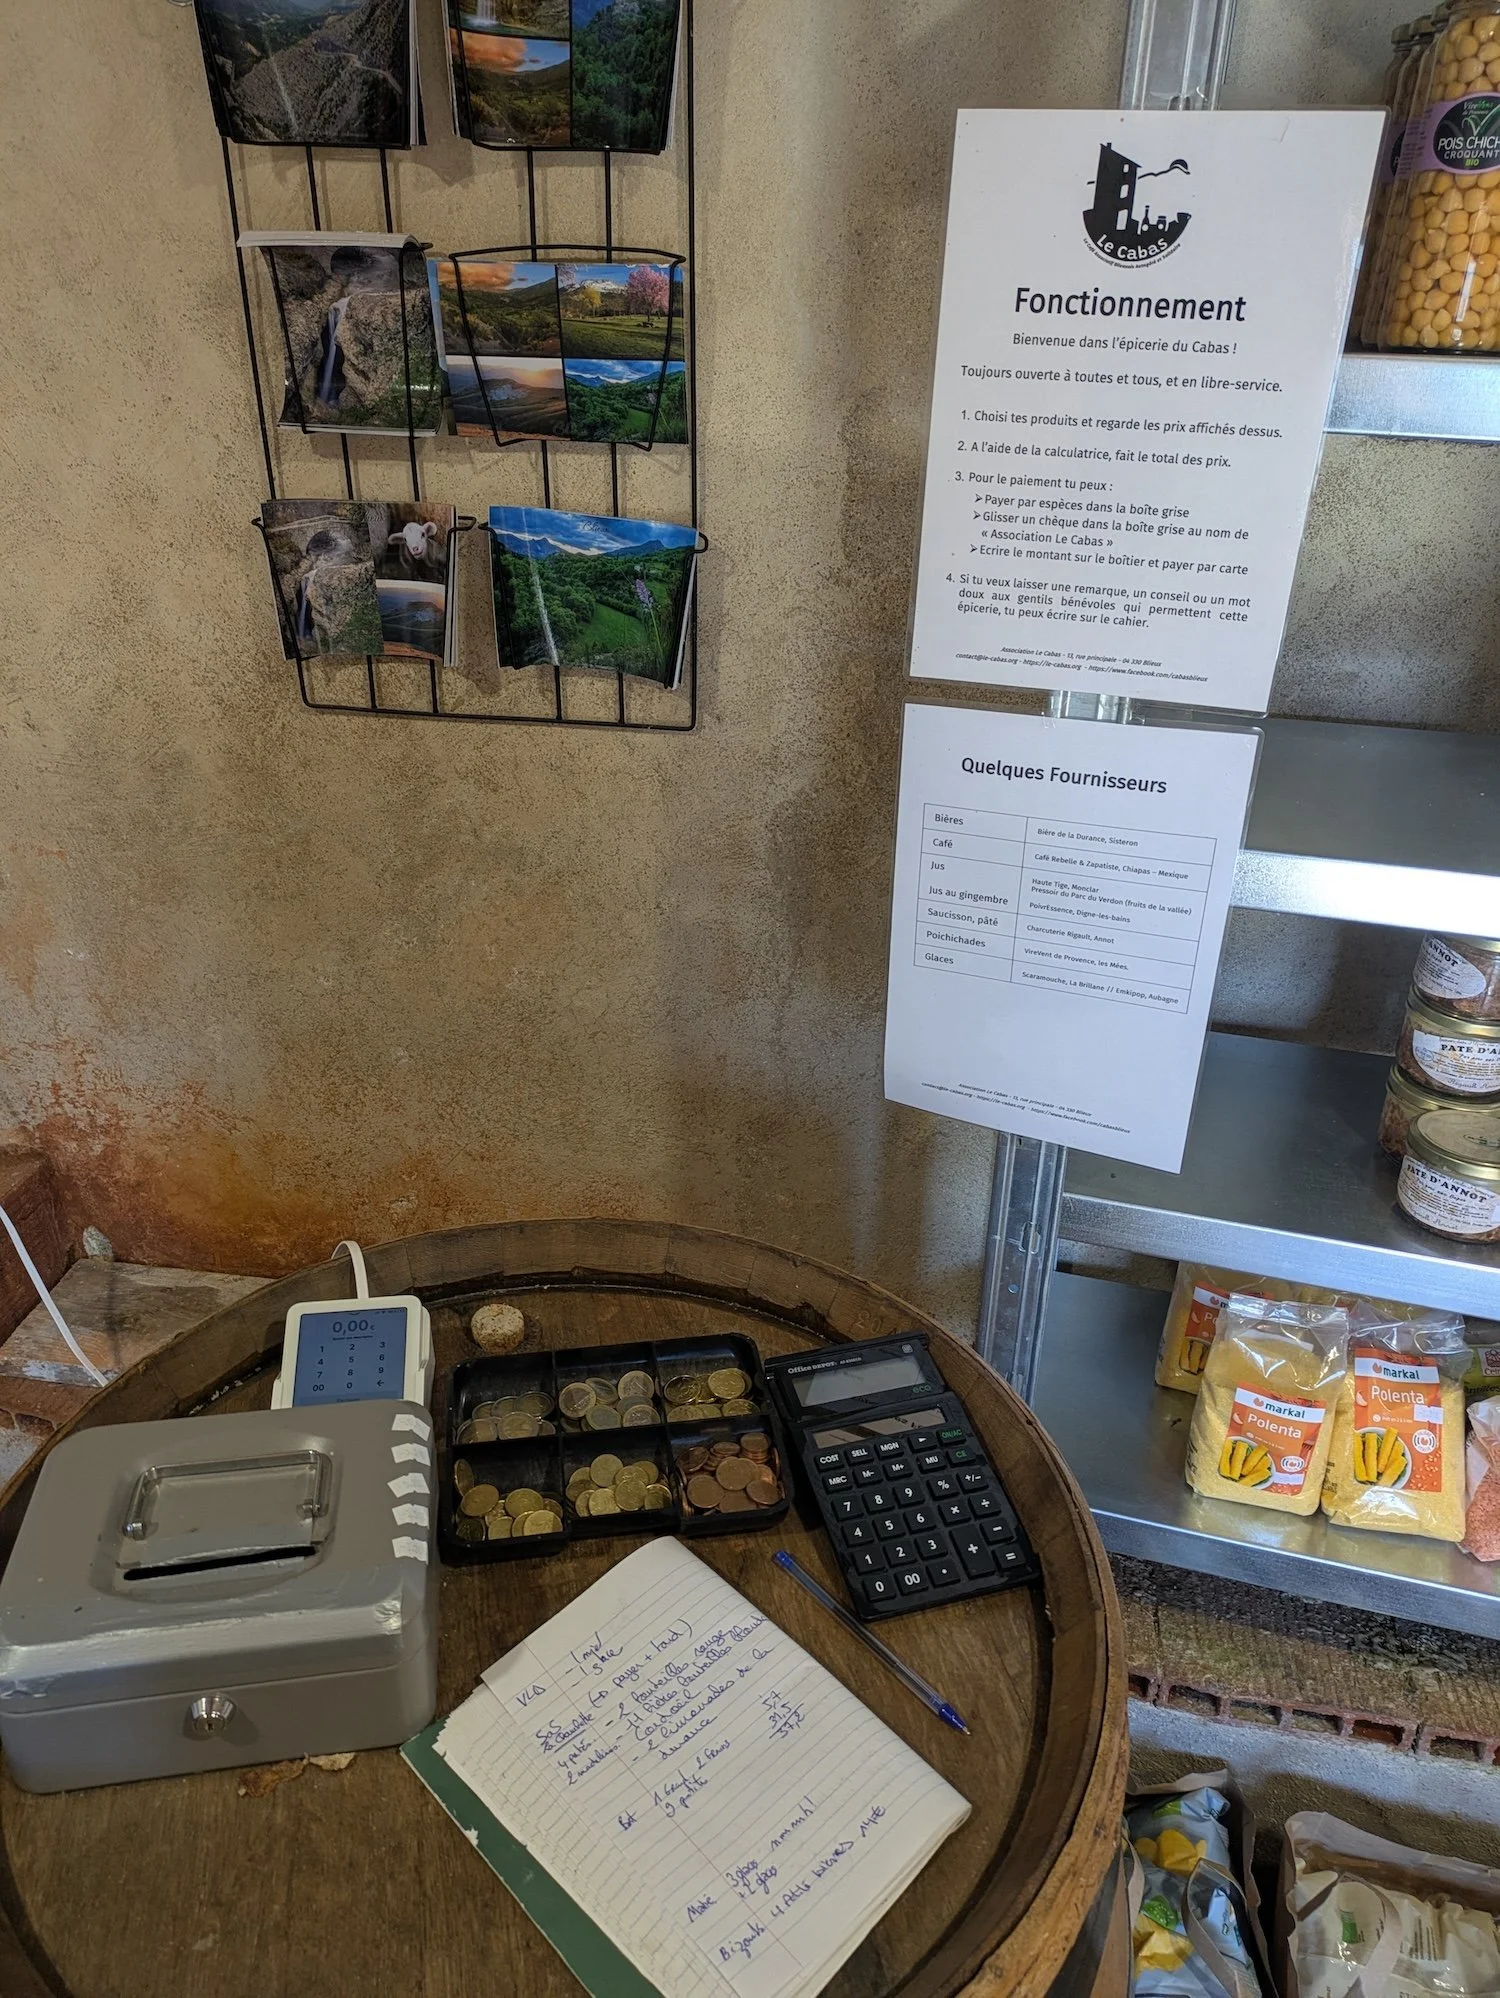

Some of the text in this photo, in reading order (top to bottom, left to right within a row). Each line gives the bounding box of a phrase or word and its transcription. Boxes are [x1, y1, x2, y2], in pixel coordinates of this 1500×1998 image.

[1438, 136, 1464, 151] POIS
[1096, 234, 1114, 252] Le
[1117, 238, 1168, 260] Cabas
[1015, 287, 1247, 322] Fonctionnement
[1013, 332, 1237, 354] Bienvenue dans l'épicerie du Cabas !
[961, 365, 1282, 392] Toujours ouverte à toutes et tous, et en libre-service.
[961, 409, 1283, 438] 1. Choisi tes produits et regarde les prix affichés dessus.
[957, 440, 1231, 469] 2. A l'aide de la calculatrice, fait le total des prix.
[955, 471, 1113, 492] 3. Pour le paiement tu peux :
[985, 494, 1190, 519] Payer par espèces dans la boîte grise
[961, 757, 1167, 794] Quelques Fournisseurs
[934, 813, 964, 826] Bières
[932, 838, 953, 848] Café
[1037, 828, 1056, 836] Bière
[1108, 837, 1138, 847] Sisteron
[930, 861, 945, 871] Jus
[1034, 853, 1050, 861] Café
[1051, 855, 1078, 865] Rebelle
[1122, 865, 1151, 875] Chiapas
[1158, 870, 1189, 880] Mexique
[1032, 878, 1052, 887] Haute
[1071, 884, 1100, 893] Monclar
[928, 885, 1009, 905] Jus au gingembre
[1031, 886, 1059, 896] Pressoir
[1070, 892, 1086, 900] Parc
[1098, 896, 1124, 905] Verdon
[1125, 899, 1146, 909] (fruits
[1147, 903, 1157, 911] de
[1167, 907, 1192, 916] vallée)
[927, 907, 998, 926] Saucisson, pâté
[1076, 909, 1131, 923] Digne-les-bains
[926, 930, 986, 947] Poichichades
[1026, 925, 1066, 936] Charcuterie
[1093, 935, 1114, 944] Annot
[924, 952, 954, 964] Glaces
[1024, 948, 1052, 958] VireVent
[1078, 981, 1105, 991] Brillane
[1148, 993, 1179, 1004] Aubagne
[1429, 1176, 1487, 1203] D'ANNOT
[1383, 1366, 1420, 1380] markal
[1371, 1386, 1425, 1404] Polenta
[1265, 1401, 1306, 1419] markal
[1247, 1413, 1302, 1439] Polenta
[851, 1449, 868, 1457] SELL
[880, 1442, 899, 1451] MGN
[820, 1454, 839, 1464] COST
[925, 1456, 938, 1464] MU
[829, 1476, 847, 1485] MRC
[875, 1495, 883, 1504] 8
[905, 1488, 912, 1497] 9
[843, 1501, 850, 1511] 7
[885, 1520, 893, 1530] 5
[917, 1513, 925, 1523] 6
[854, 1527, 862, 1536] 4
[896, 1547, 905, 1557] 2
[928, 1540, 936, 1550] 3
[865, 1555, 872, 1564] 1
[905, 1573, 920, 1585] 00
[875, 1581, 884, 1592] 0
